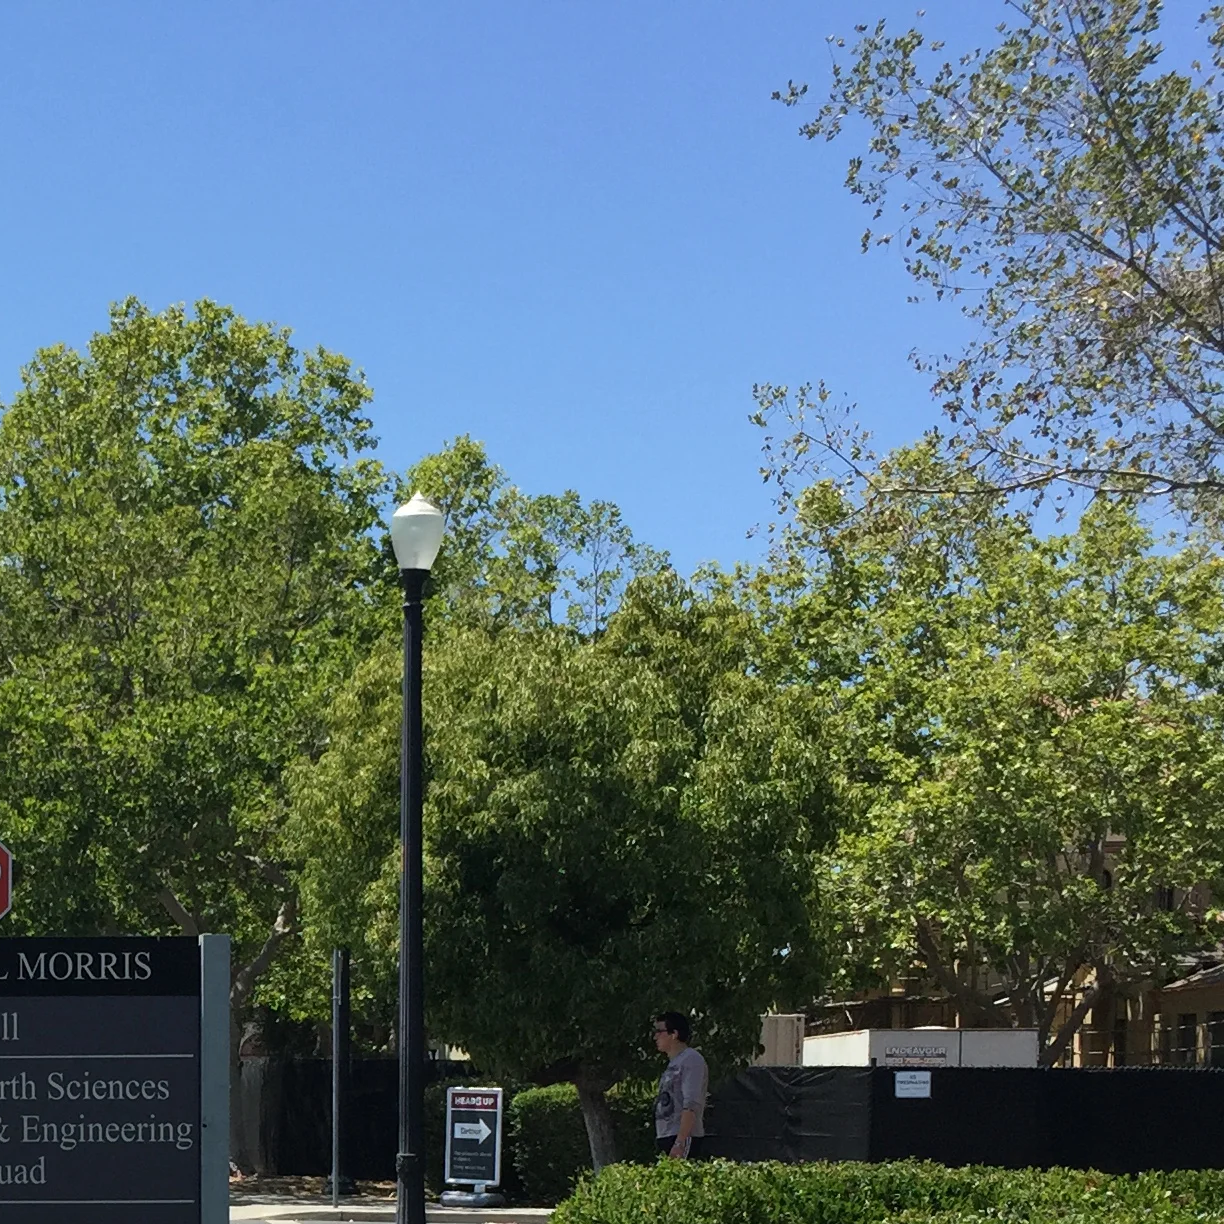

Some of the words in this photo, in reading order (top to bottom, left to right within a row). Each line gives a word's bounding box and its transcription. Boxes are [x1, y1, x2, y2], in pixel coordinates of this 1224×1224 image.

[17, 952, 152, 981] MORRIS
[47, 1072, 170, 1101] Sciences
[482, 1097, 495, 1106] UP
[21, 1114, 194, 1150] Engineering
